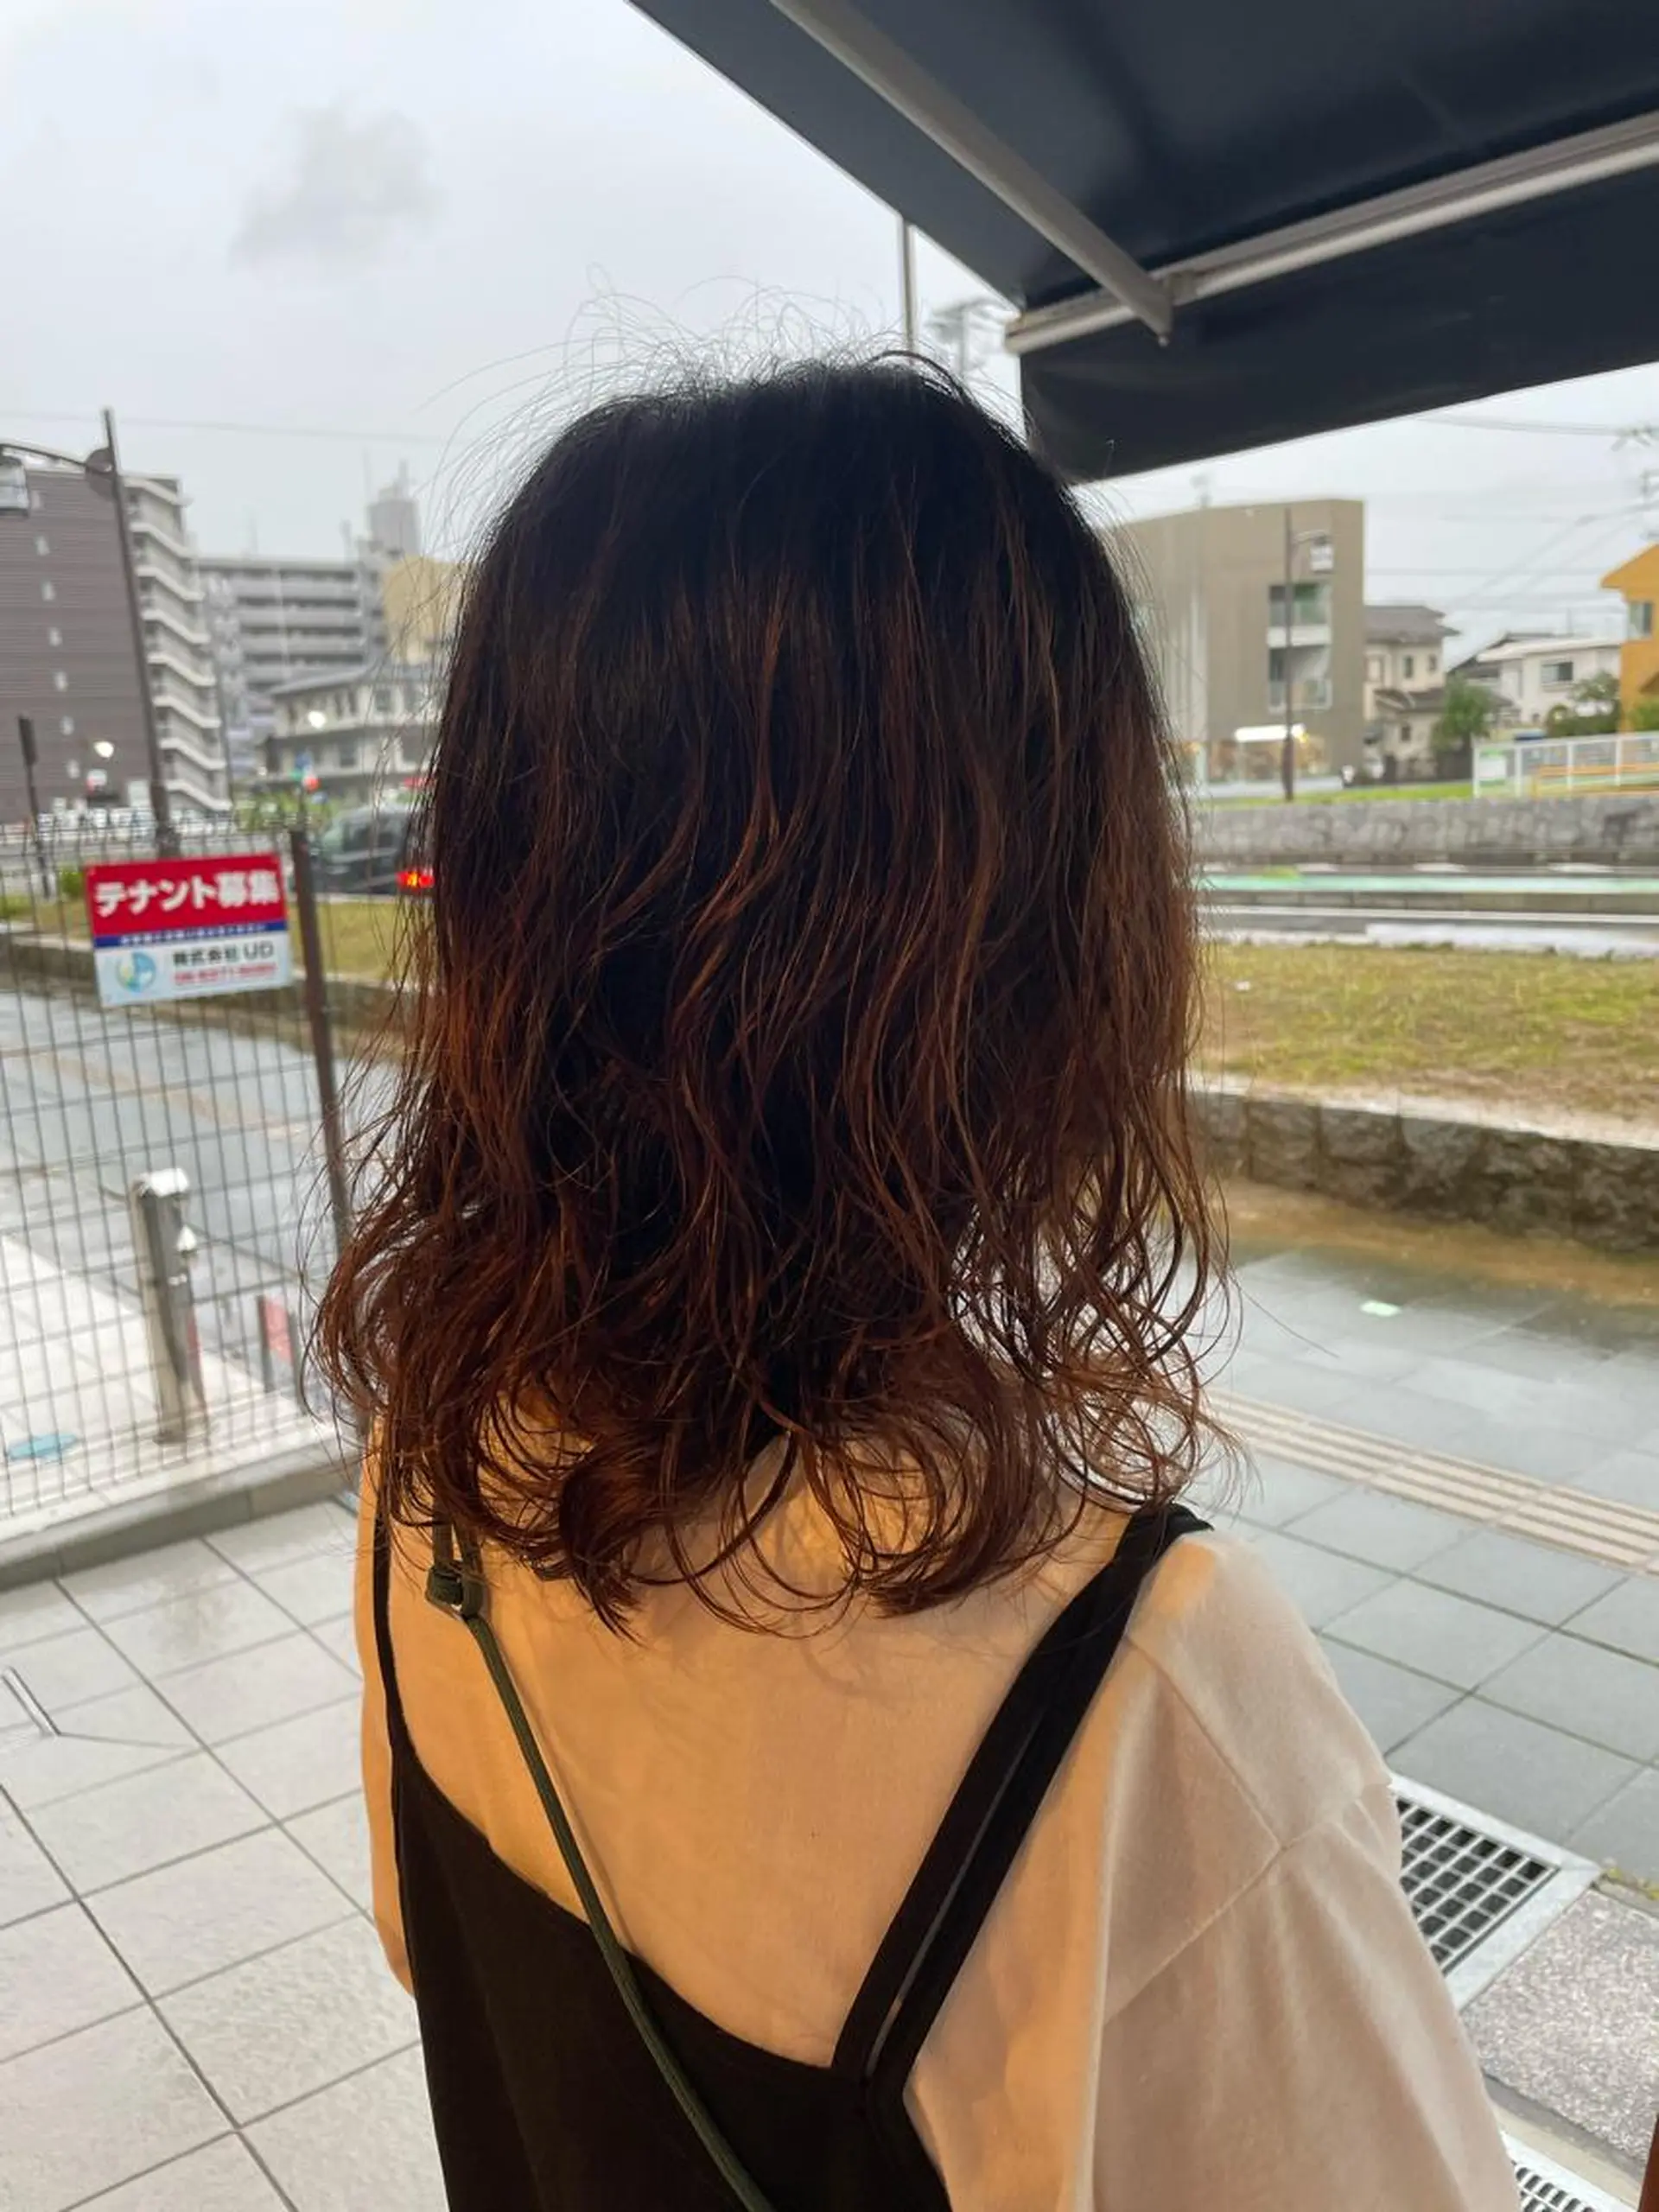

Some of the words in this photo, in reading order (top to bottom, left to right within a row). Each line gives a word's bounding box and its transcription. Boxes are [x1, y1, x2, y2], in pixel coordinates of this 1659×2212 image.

[94, 870, 281, 918] テナント募集
[173, 947, 238, 967] 株式会社
